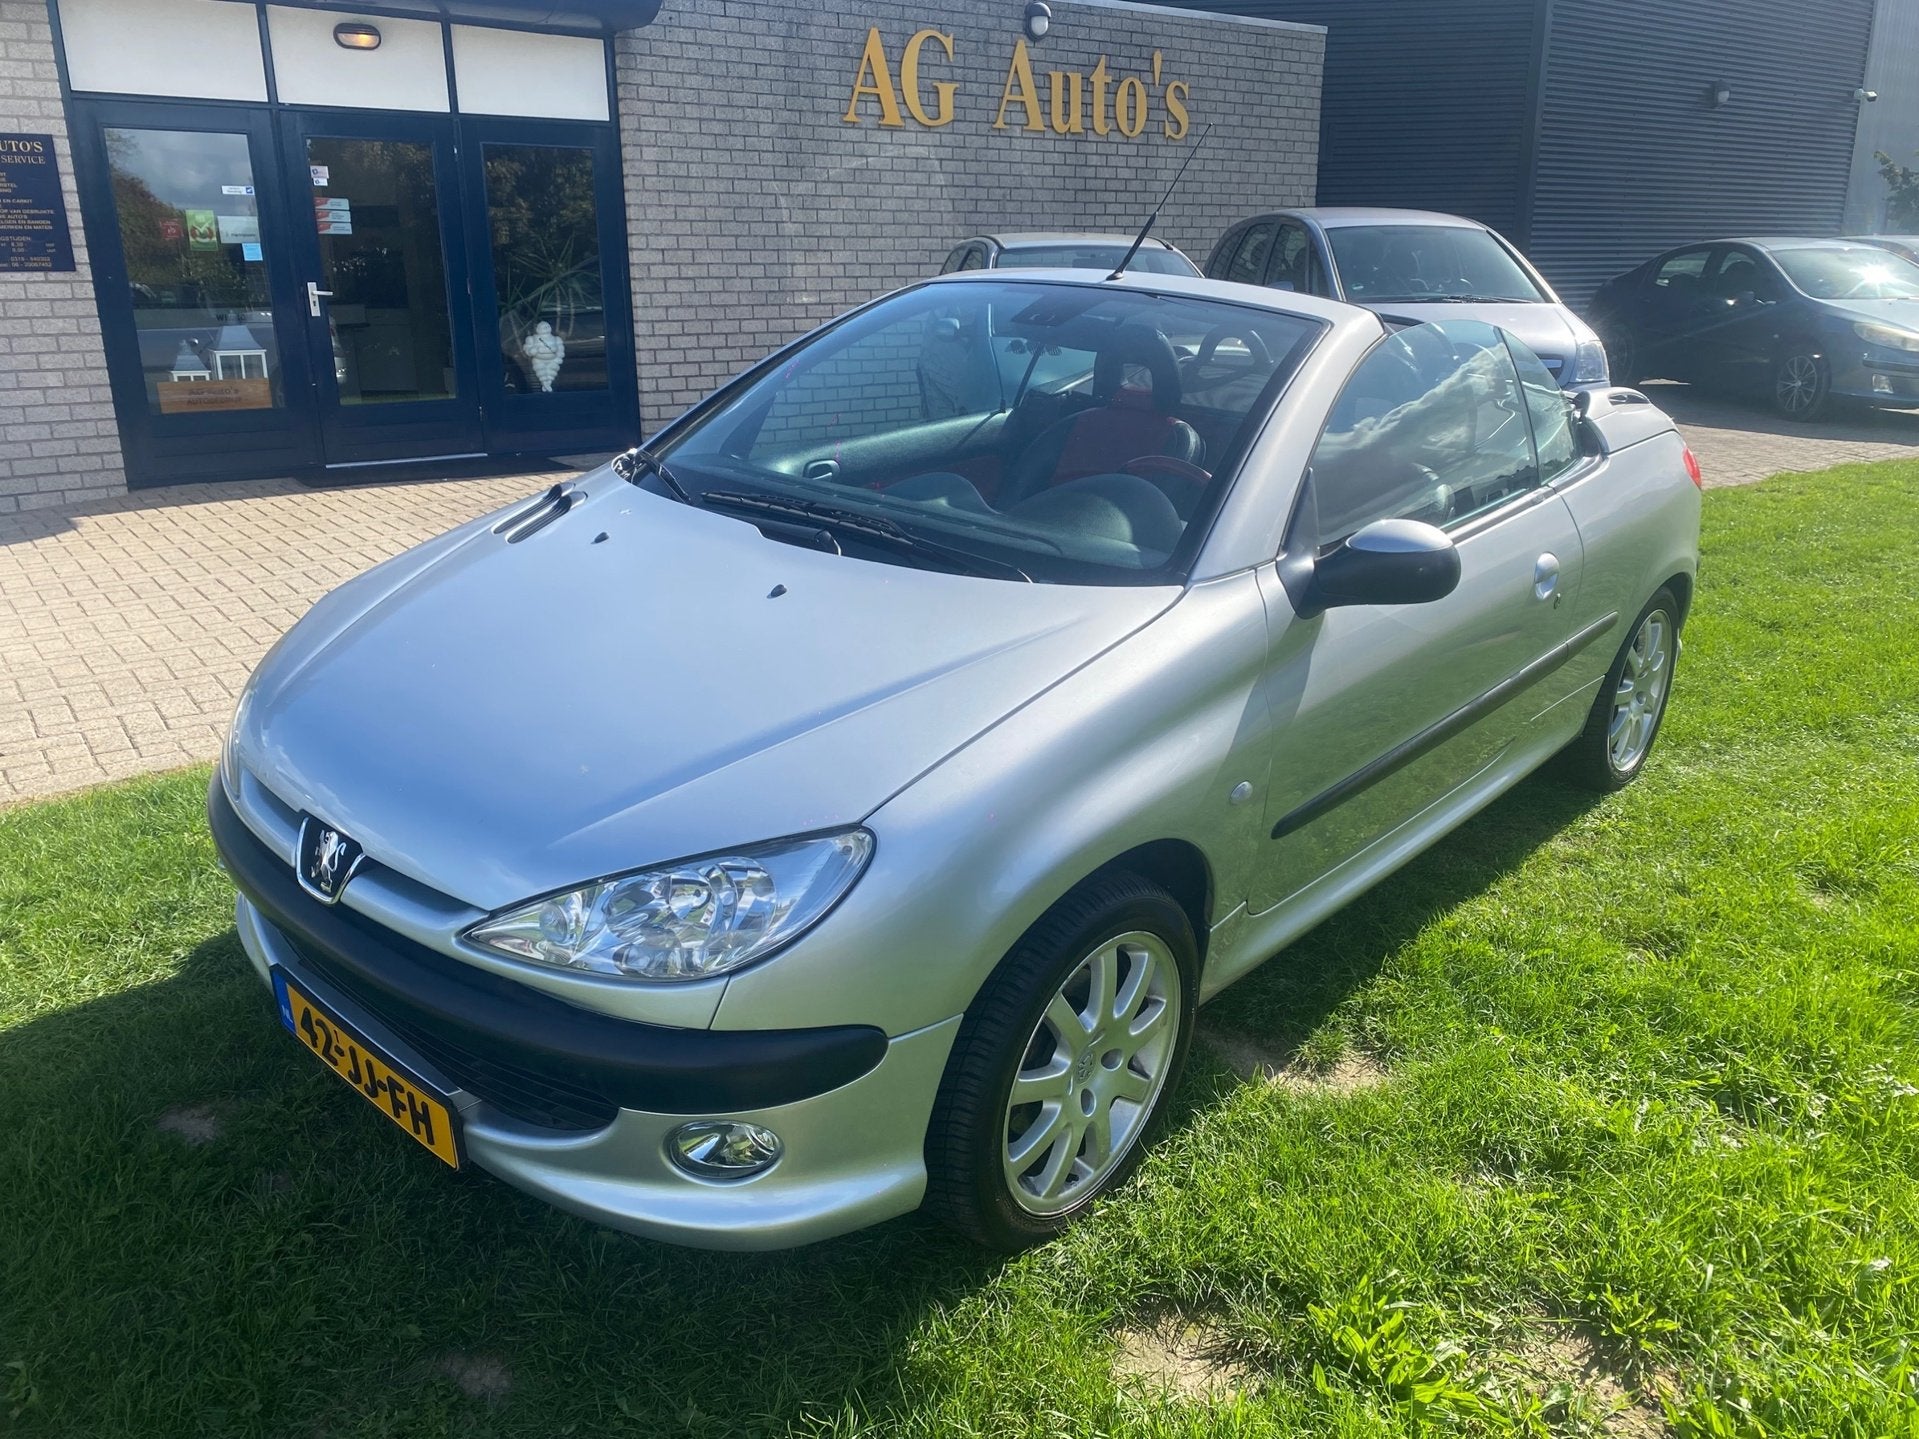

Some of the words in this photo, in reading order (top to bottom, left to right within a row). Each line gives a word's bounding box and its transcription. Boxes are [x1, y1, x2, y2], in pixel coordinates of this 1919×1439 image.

[842, 26, 960, 128] AG
[992, 39, 1190, 141] Auto's
[1, 154, 46, 165] SERVICE
[300, 1006, 435, 1146] 42-JJ-FH
